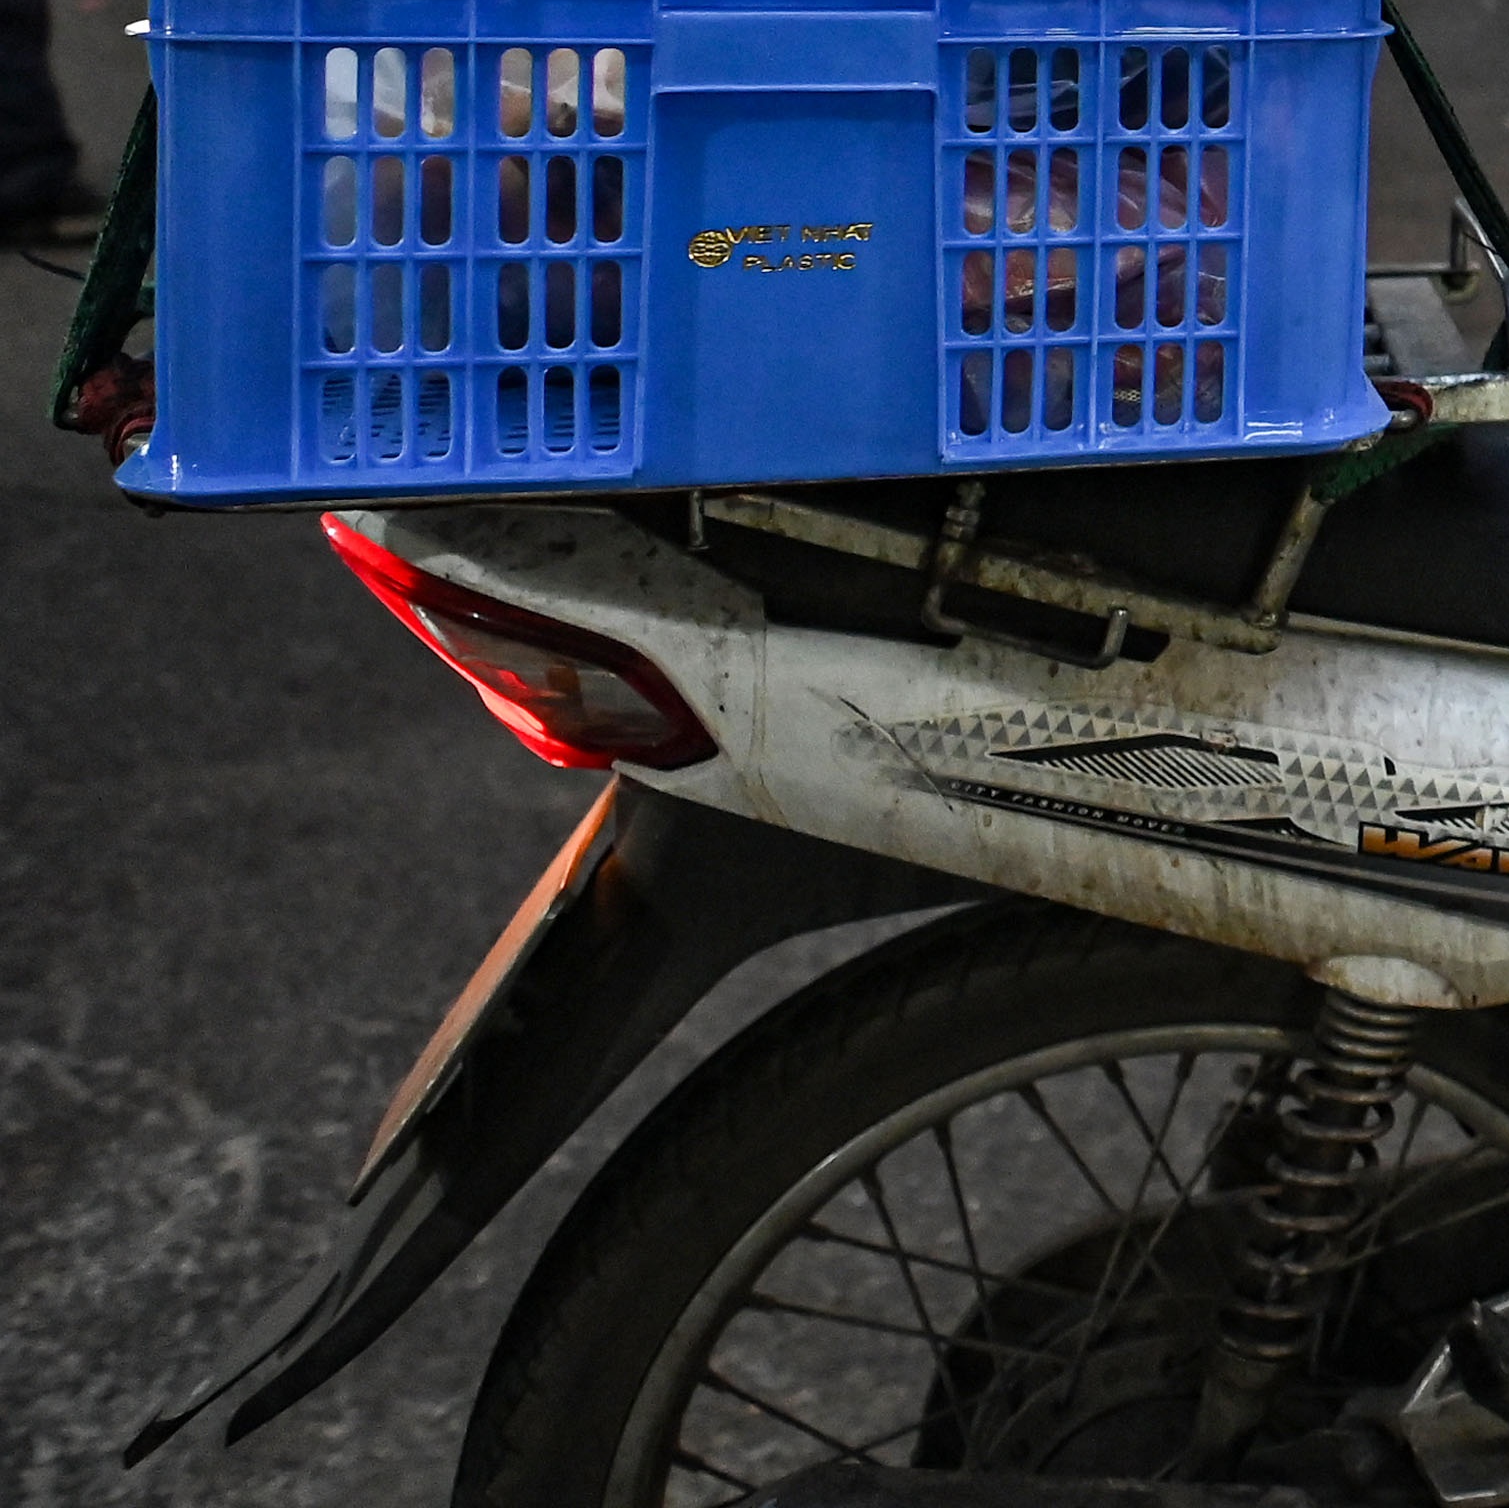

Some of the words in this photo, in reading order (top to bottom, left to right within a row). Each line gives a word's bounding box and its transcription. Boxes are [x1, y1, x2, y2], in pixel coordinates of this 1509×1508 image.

[743, 251, 857, 273] PLASTIC
[950, 781, 1000, 798] CITY
[1011, 792, 1105, 819] FASHION
